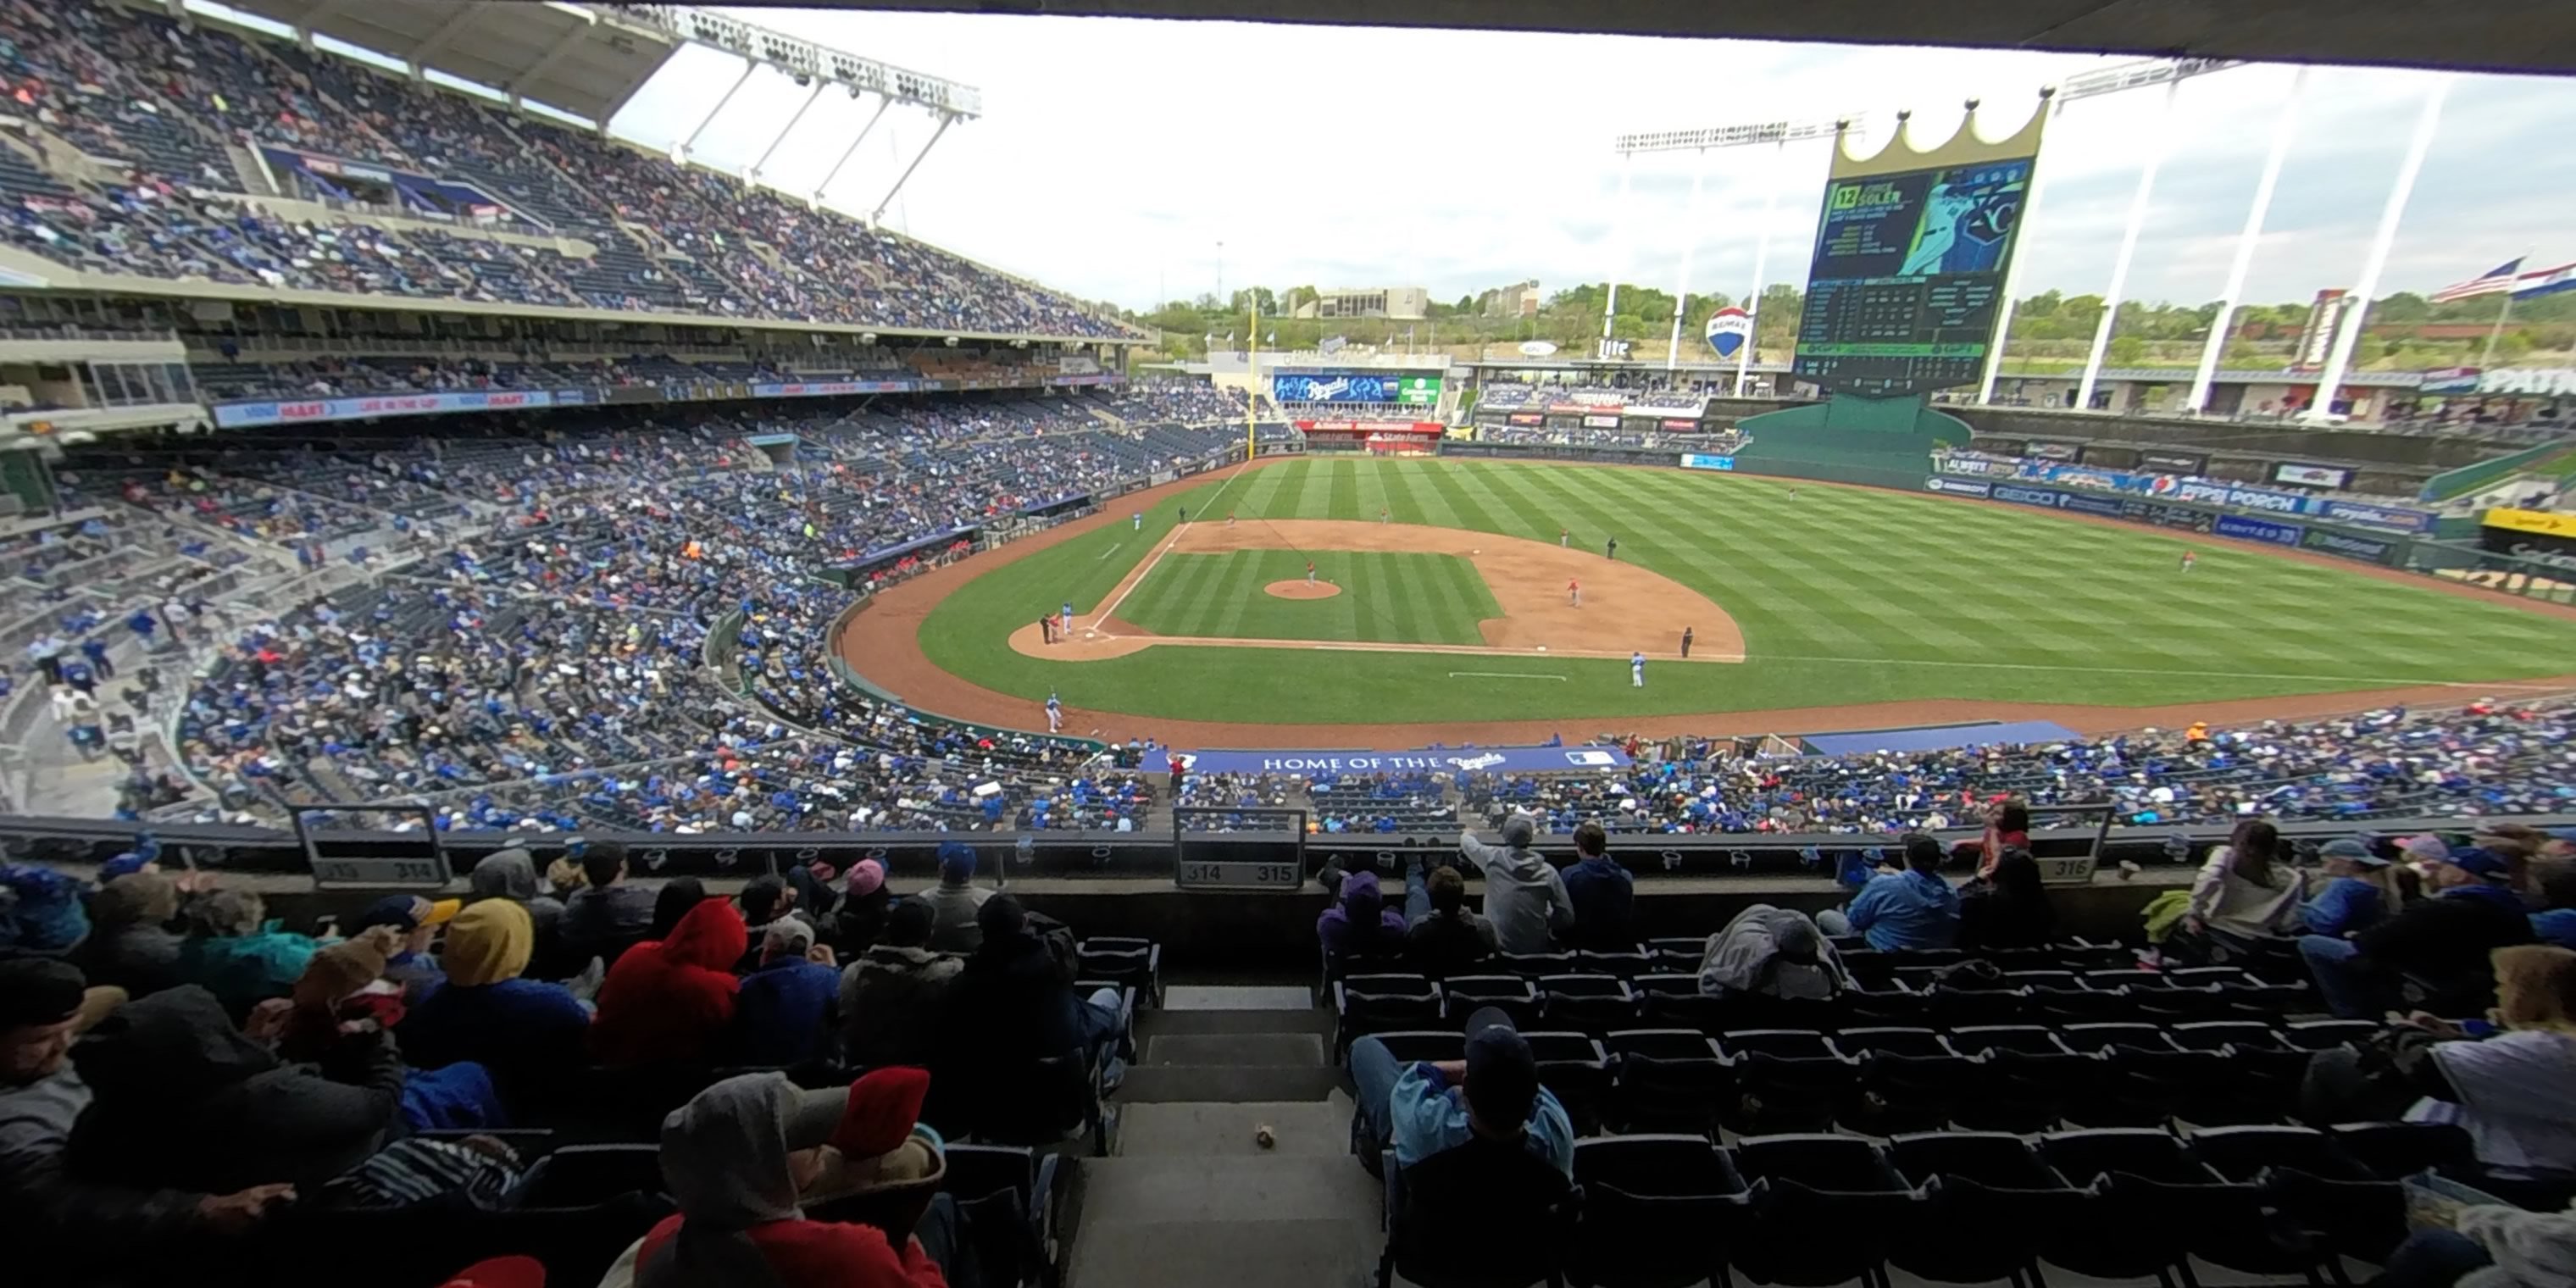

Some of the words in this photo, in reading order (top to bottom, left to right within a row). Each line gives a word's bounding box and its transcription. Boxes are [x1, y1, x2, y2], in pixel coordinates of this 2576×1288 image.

[1840, 190, 1856, 204] 12
[1857, 192, 1901, 206] SOLER
[1308, 376, 1350, 400] Royals
[1993, 487, 2057, 506] GEICO
[2180, 484, 2229, 504] PEPSI
[2230, 490, 2296, 512] PORCH
[1263, 758, 1342, 770] HOME
[1348, 758, 1381, 770] OF
[1388, 757, 1441, 769] THE
[1446, 751, 1507, 771] Royals
[1187, 864, 1222, 881] 314
[1257, 864, 1293, 883] 315
[2055, 861, 2089, 876] 316
